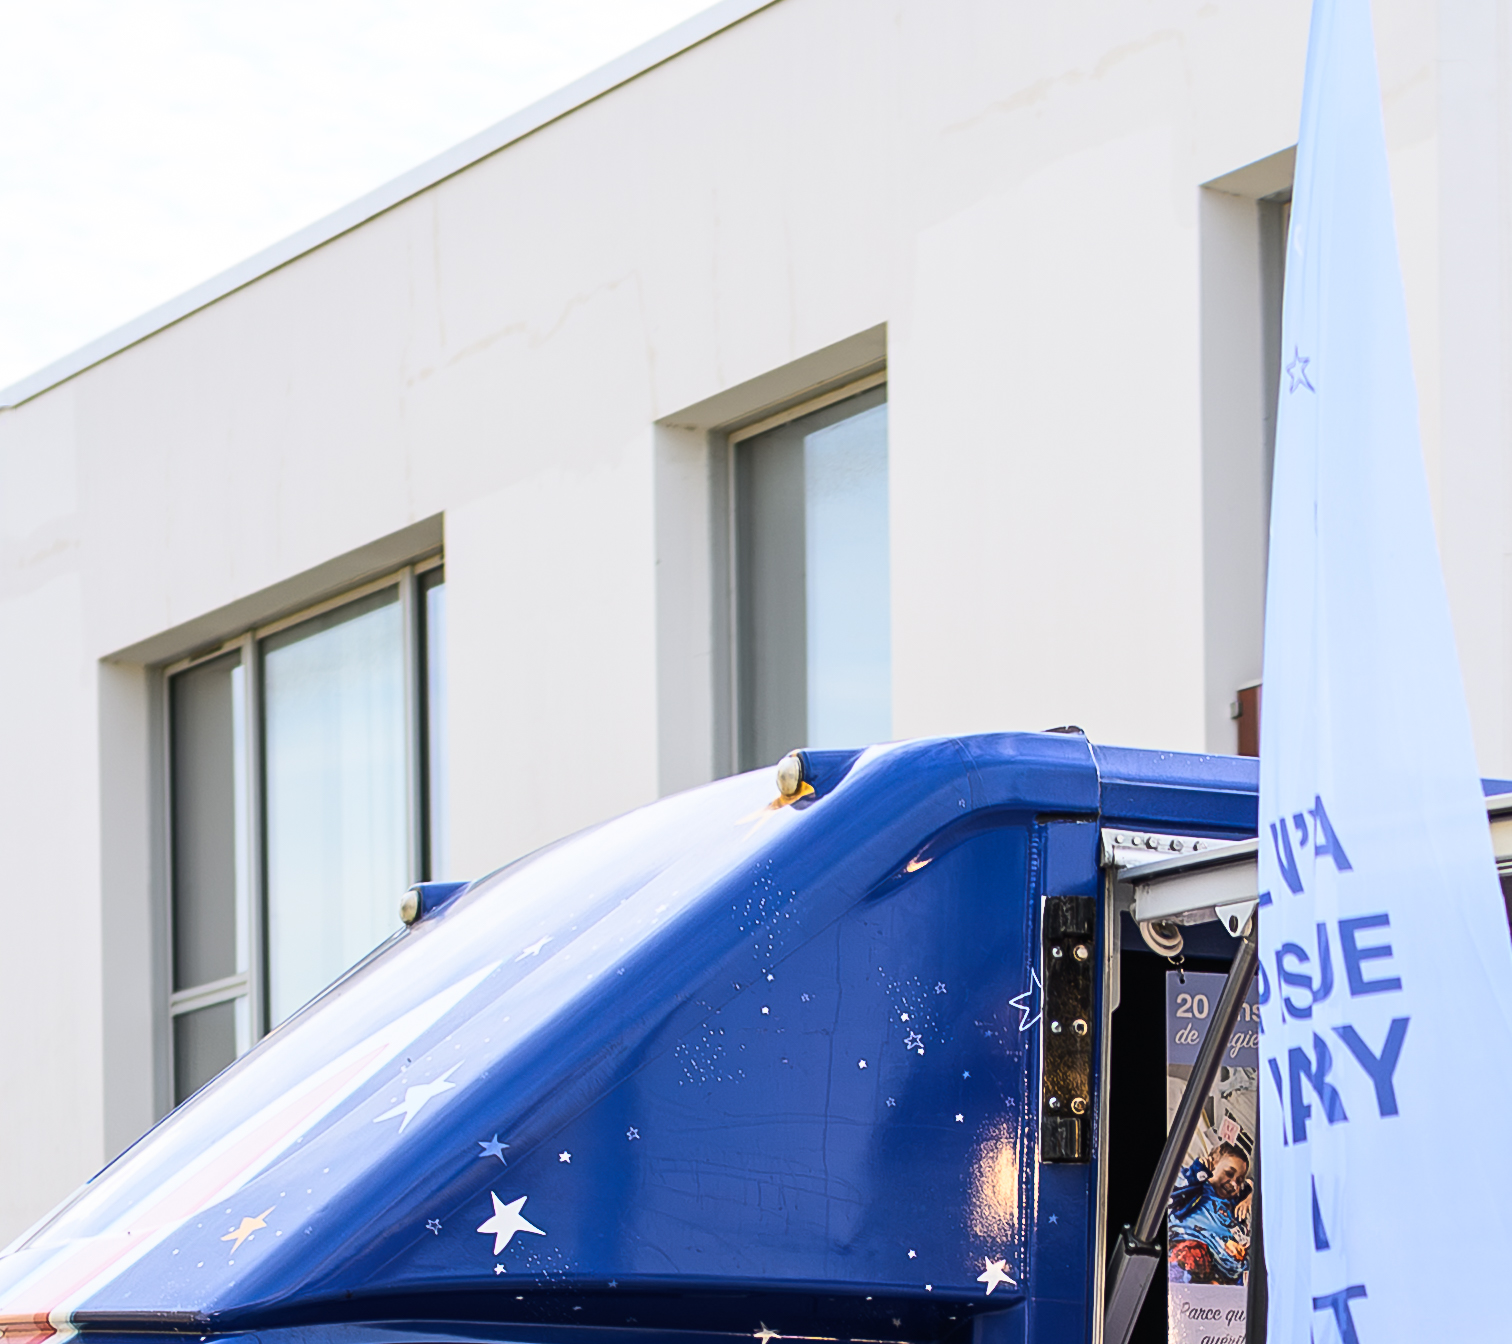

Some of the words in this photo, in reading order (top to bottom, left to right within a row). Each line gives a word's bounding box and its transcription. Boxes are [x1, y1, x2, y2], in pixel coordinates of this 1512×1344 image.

[1176, 993, 1209, 1019] 20
[1237, 1003, 1259, 1022] ns
[1175, 1022, 1200, 1045] de
[1181, 1302, 1222, 1321] Parce
